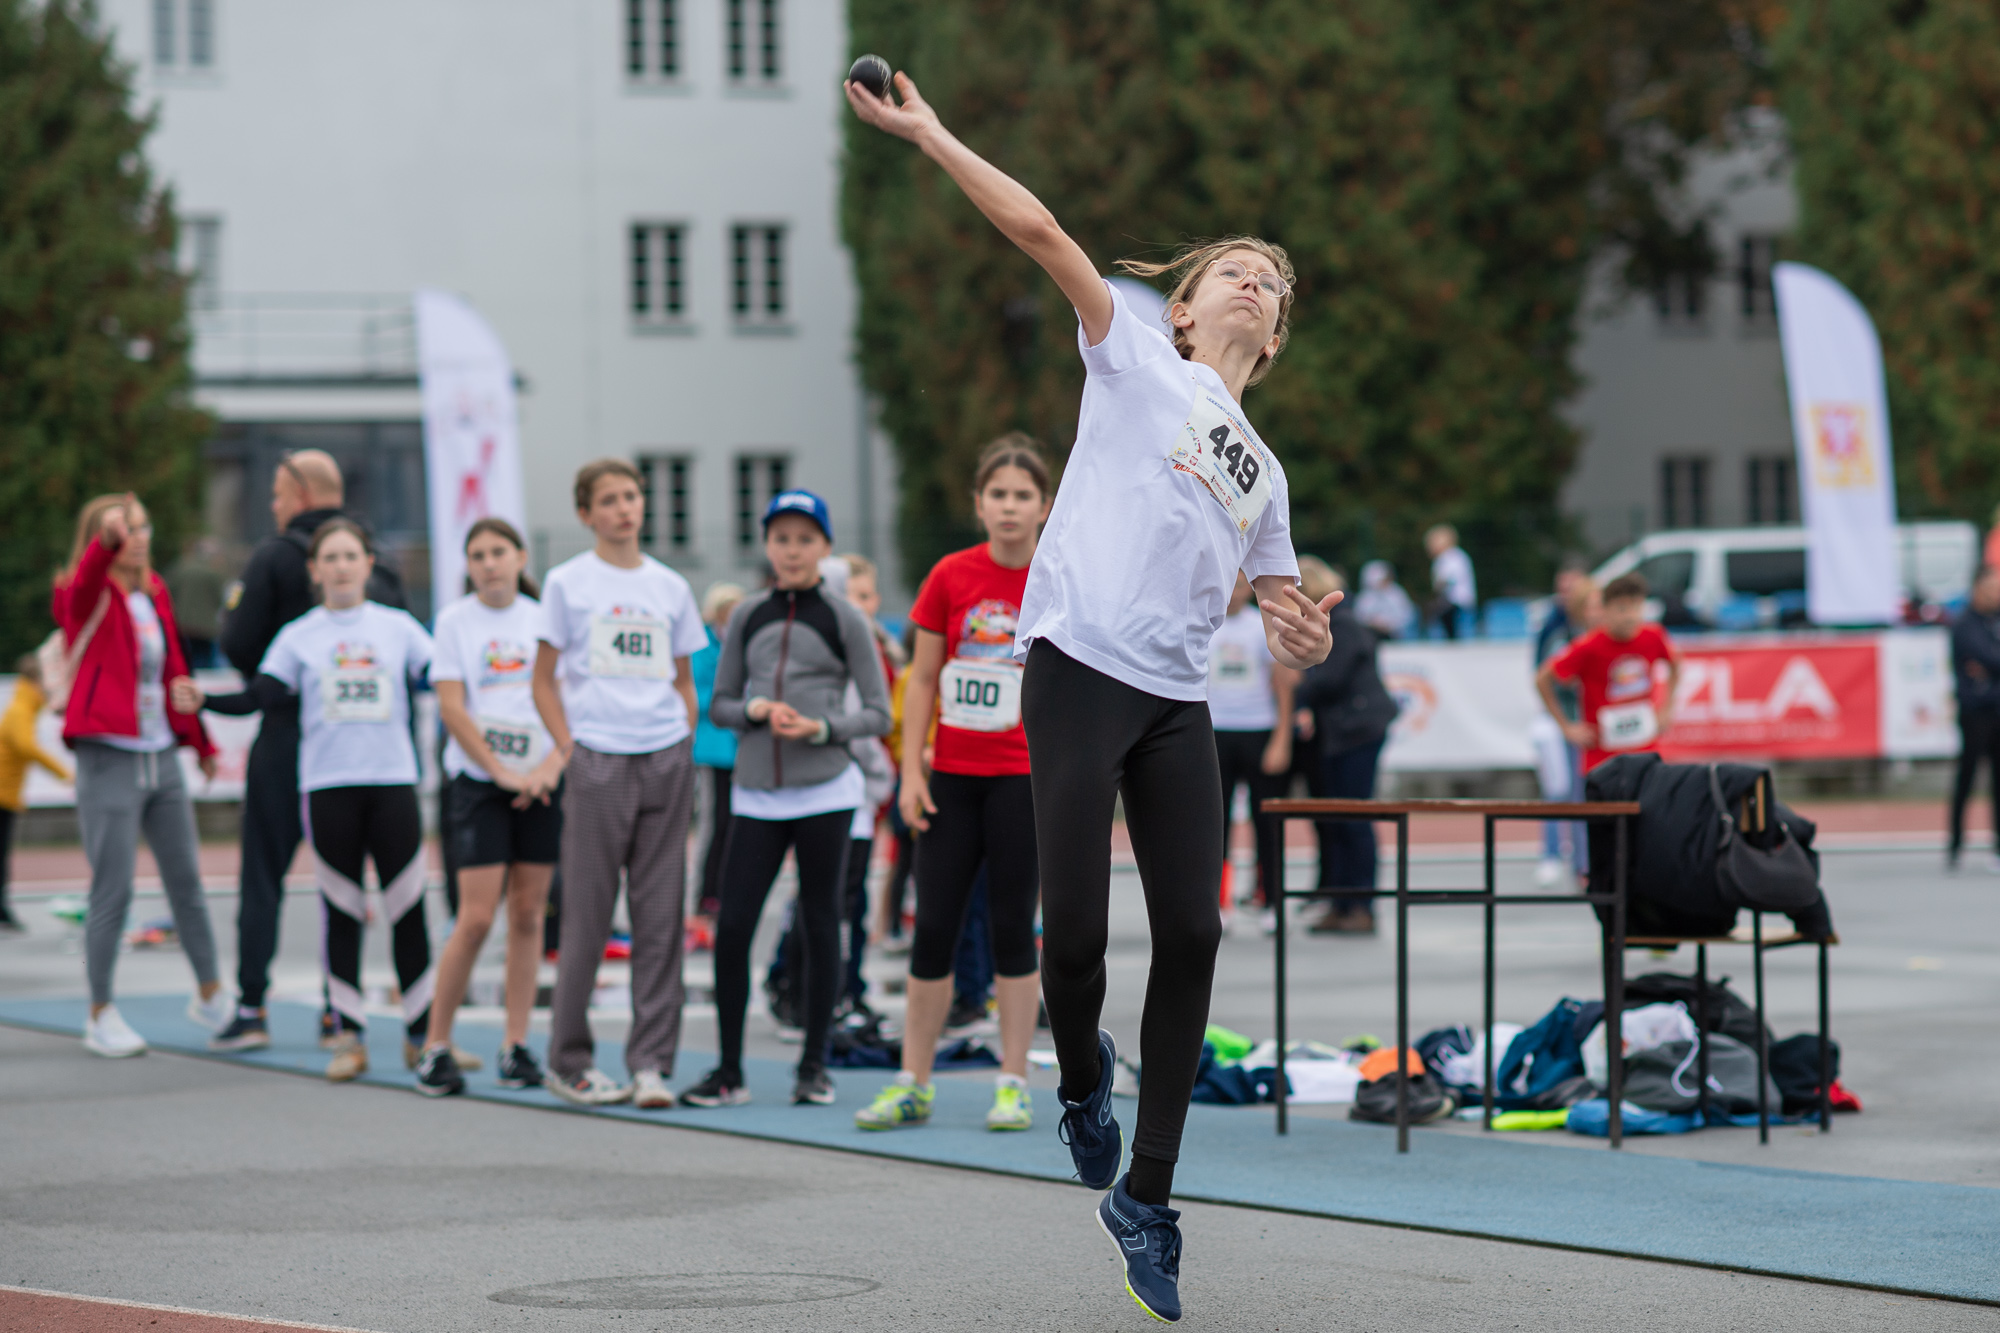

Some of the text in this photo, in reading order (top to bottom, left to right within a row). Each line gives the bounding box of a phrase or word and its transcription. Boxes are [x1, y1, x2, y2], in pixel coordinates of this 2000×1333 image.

[1208, 424, 1259, 494] 449
[611, 632, 653, 657] 481
[956, 677, 1000, 707] 100
[1662, 655, 1840, 722] ZLA
